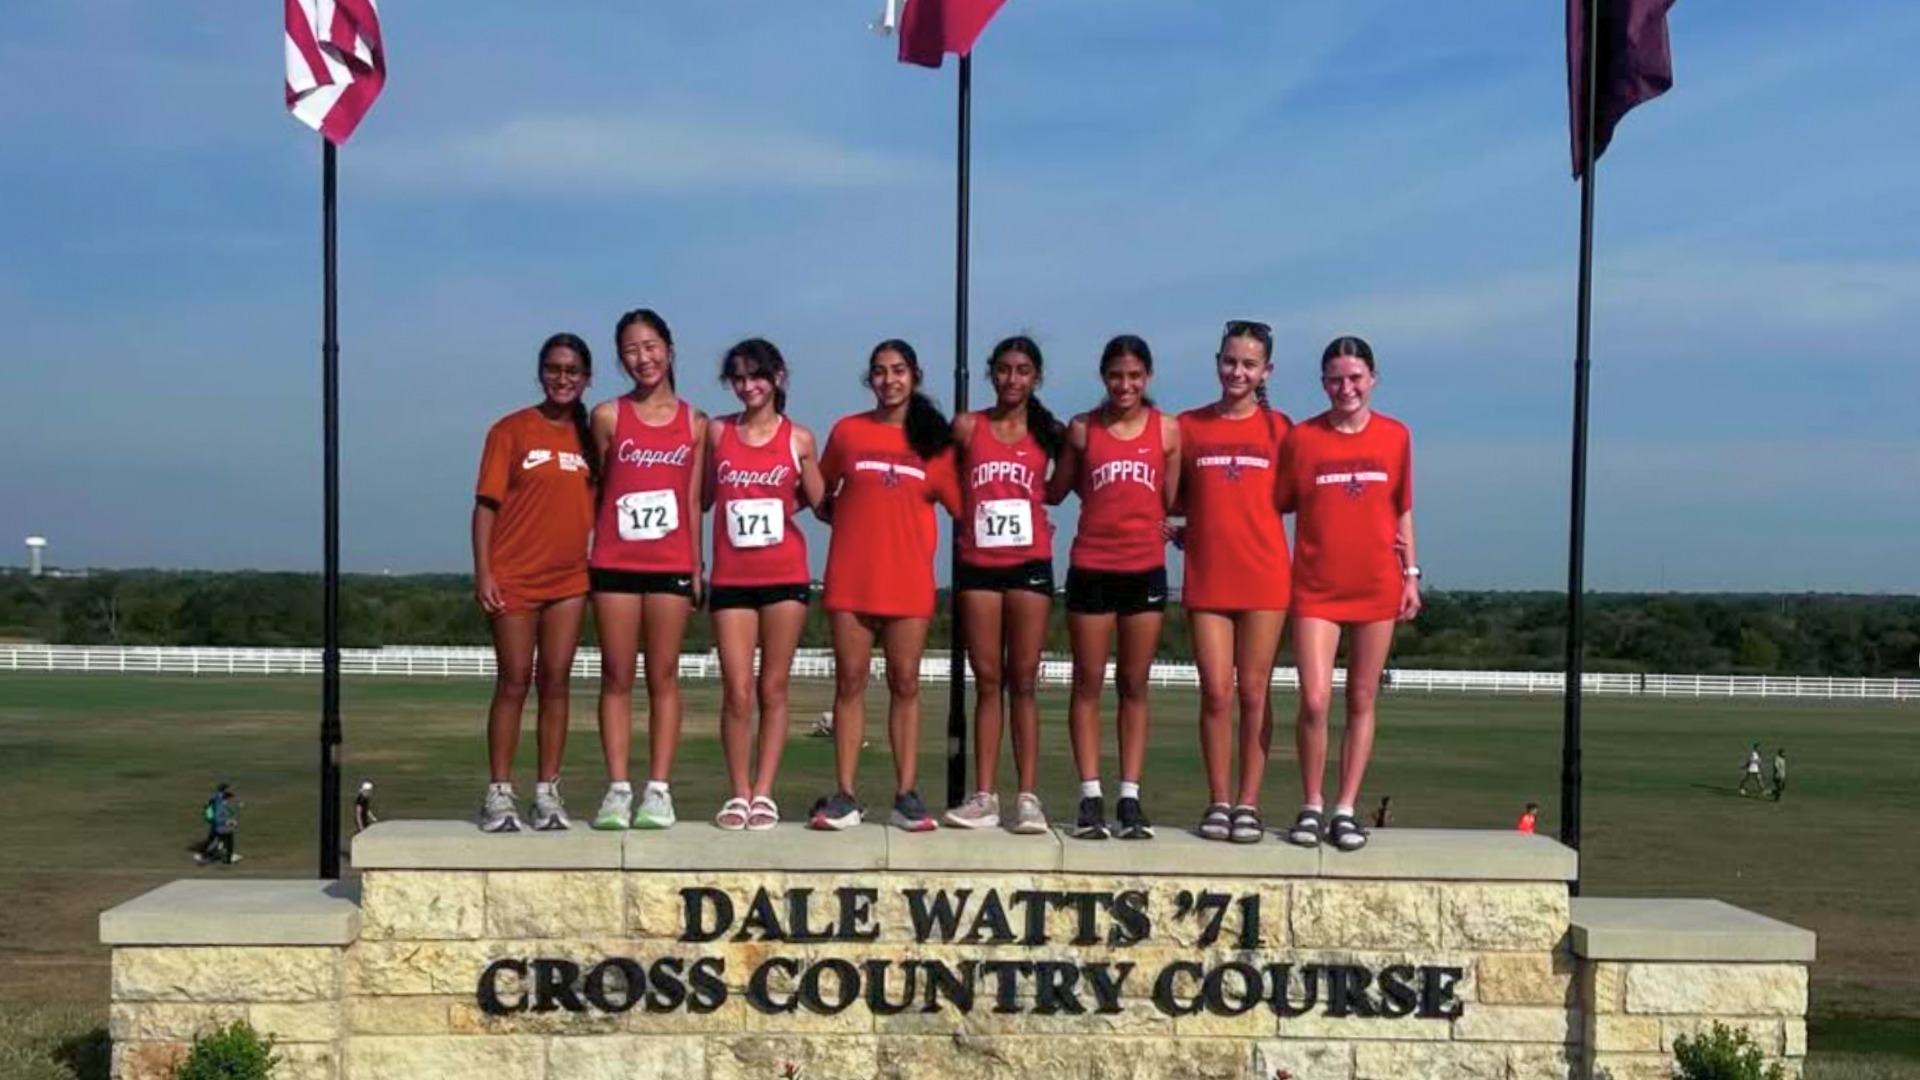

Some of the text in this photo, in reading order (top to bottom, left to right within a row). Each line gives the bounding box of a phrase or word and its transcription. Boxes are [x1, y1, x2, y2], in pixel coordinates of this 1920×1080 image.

[618, 439, 690, 468] Coppell
[717, 460, 789, 488] Coppell
[971, 461, 1034, 495] COPPELL
[1091, 460, 1155, 491] COPPELL
[630, 506, 668, 529] 172
[737, 514, 772, 536] 171
[986, 514, 1021, 536] 175
[678, 886, 1265, 949] DALE WATTS '71
[476, 956, 1464, 1018] CROSS COUNTRY COURSE
